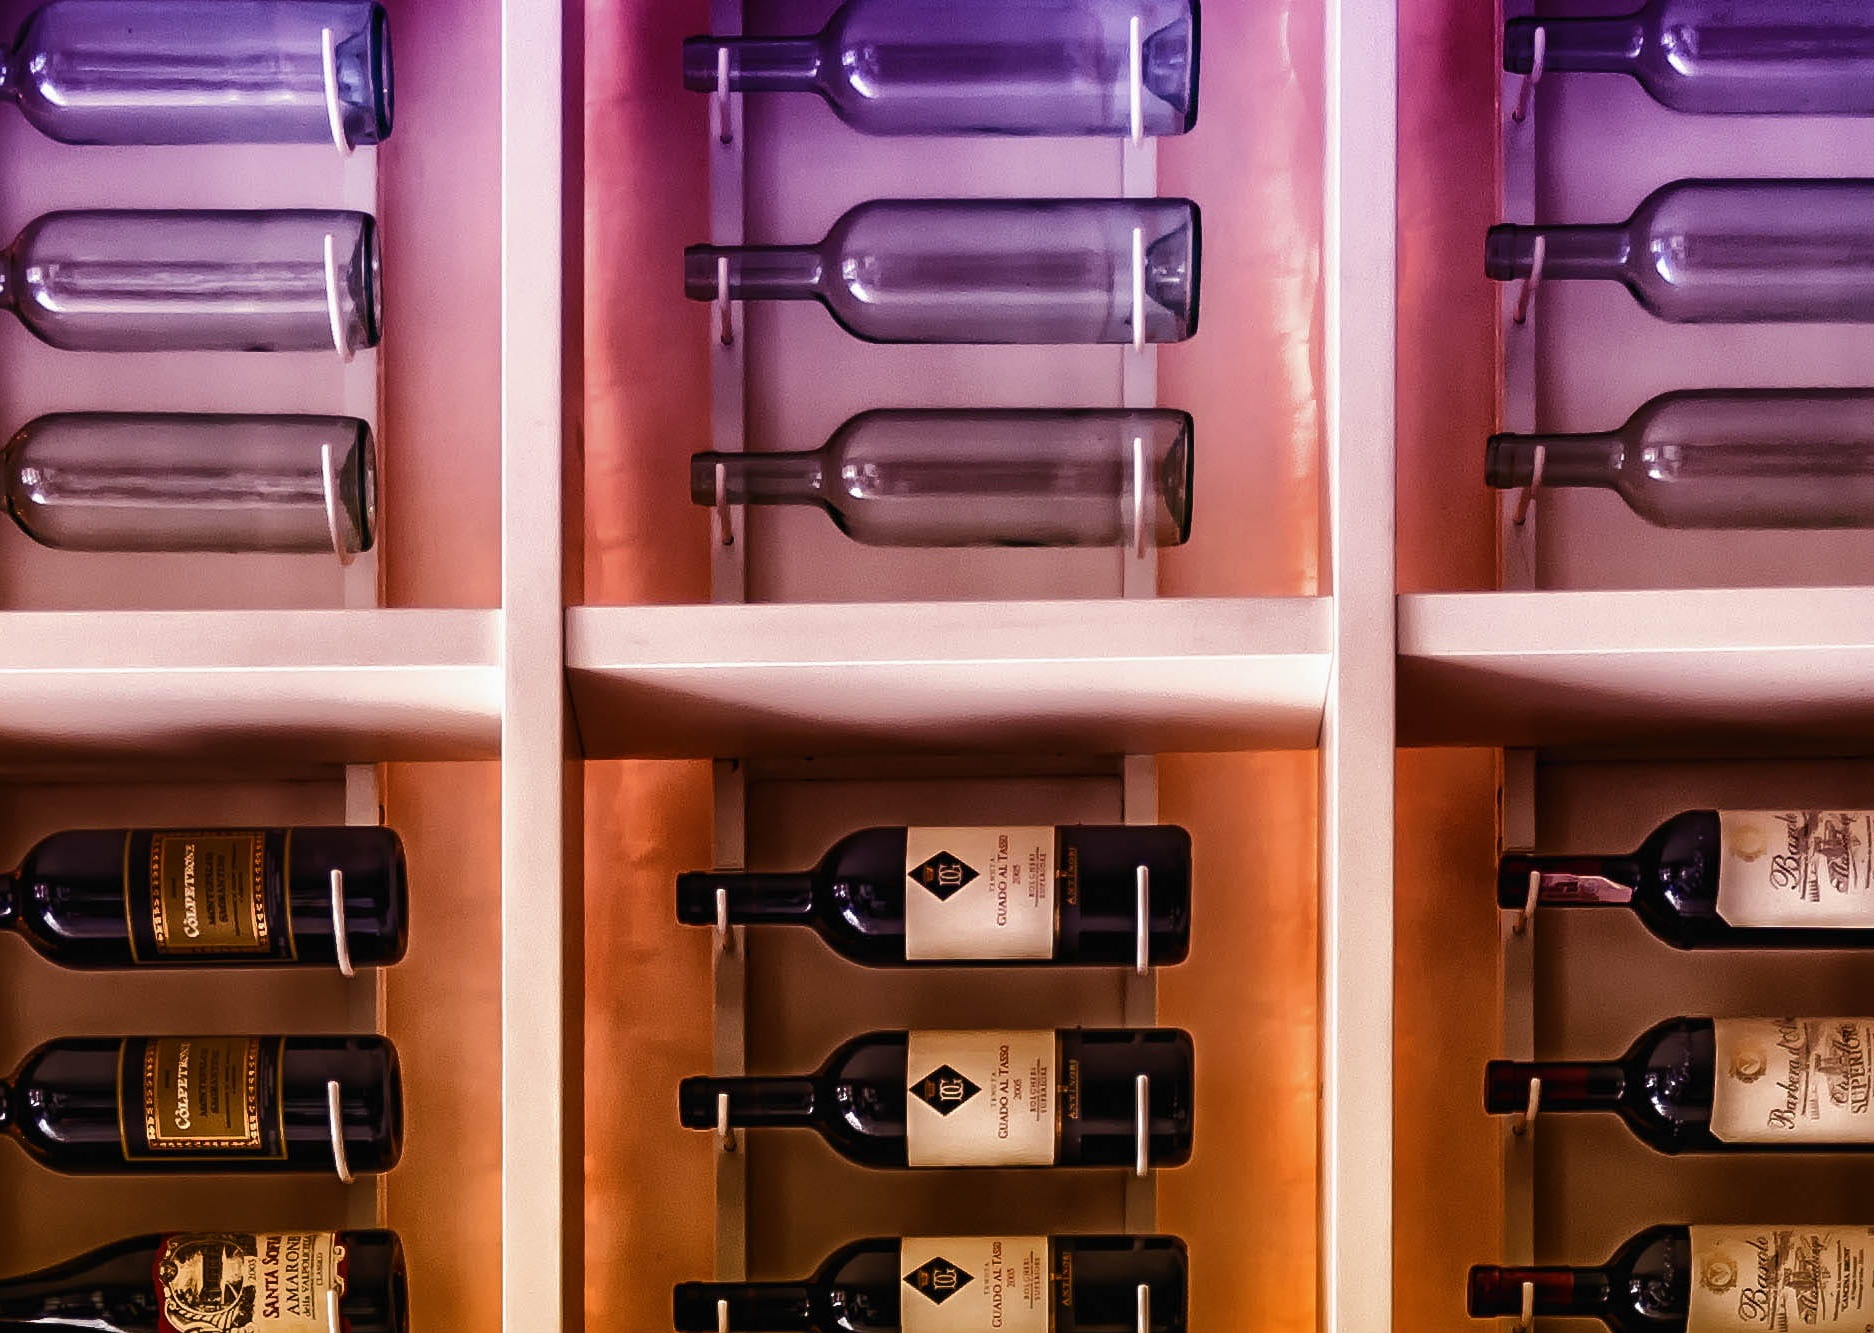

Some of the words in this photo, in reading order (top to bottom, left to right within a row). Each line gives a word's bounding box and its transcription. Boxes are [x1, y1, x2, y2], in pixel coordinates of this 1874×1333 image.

[997, 834, 1008, 862] TASSO
[997, 864, 1007, 878] AL
[997, 881, 1007, 927] GUADO
[999, 1046, 1009, 1075] TASSO
[999, 1078, 1009, 1093] AL
[1767, 1056, 1799, 1130] Barbera
[999, 1096, 1009, 1139] GUADO
[262, 1271, 280, 1319] SANTA
[285, 1235, 301, 1317] AMARONE
[992, 1268, 1002, 1282] AL
[1737, 1236, 1769, 1322] Barolo
[992, 1283, 1003, 1328] GUADO
